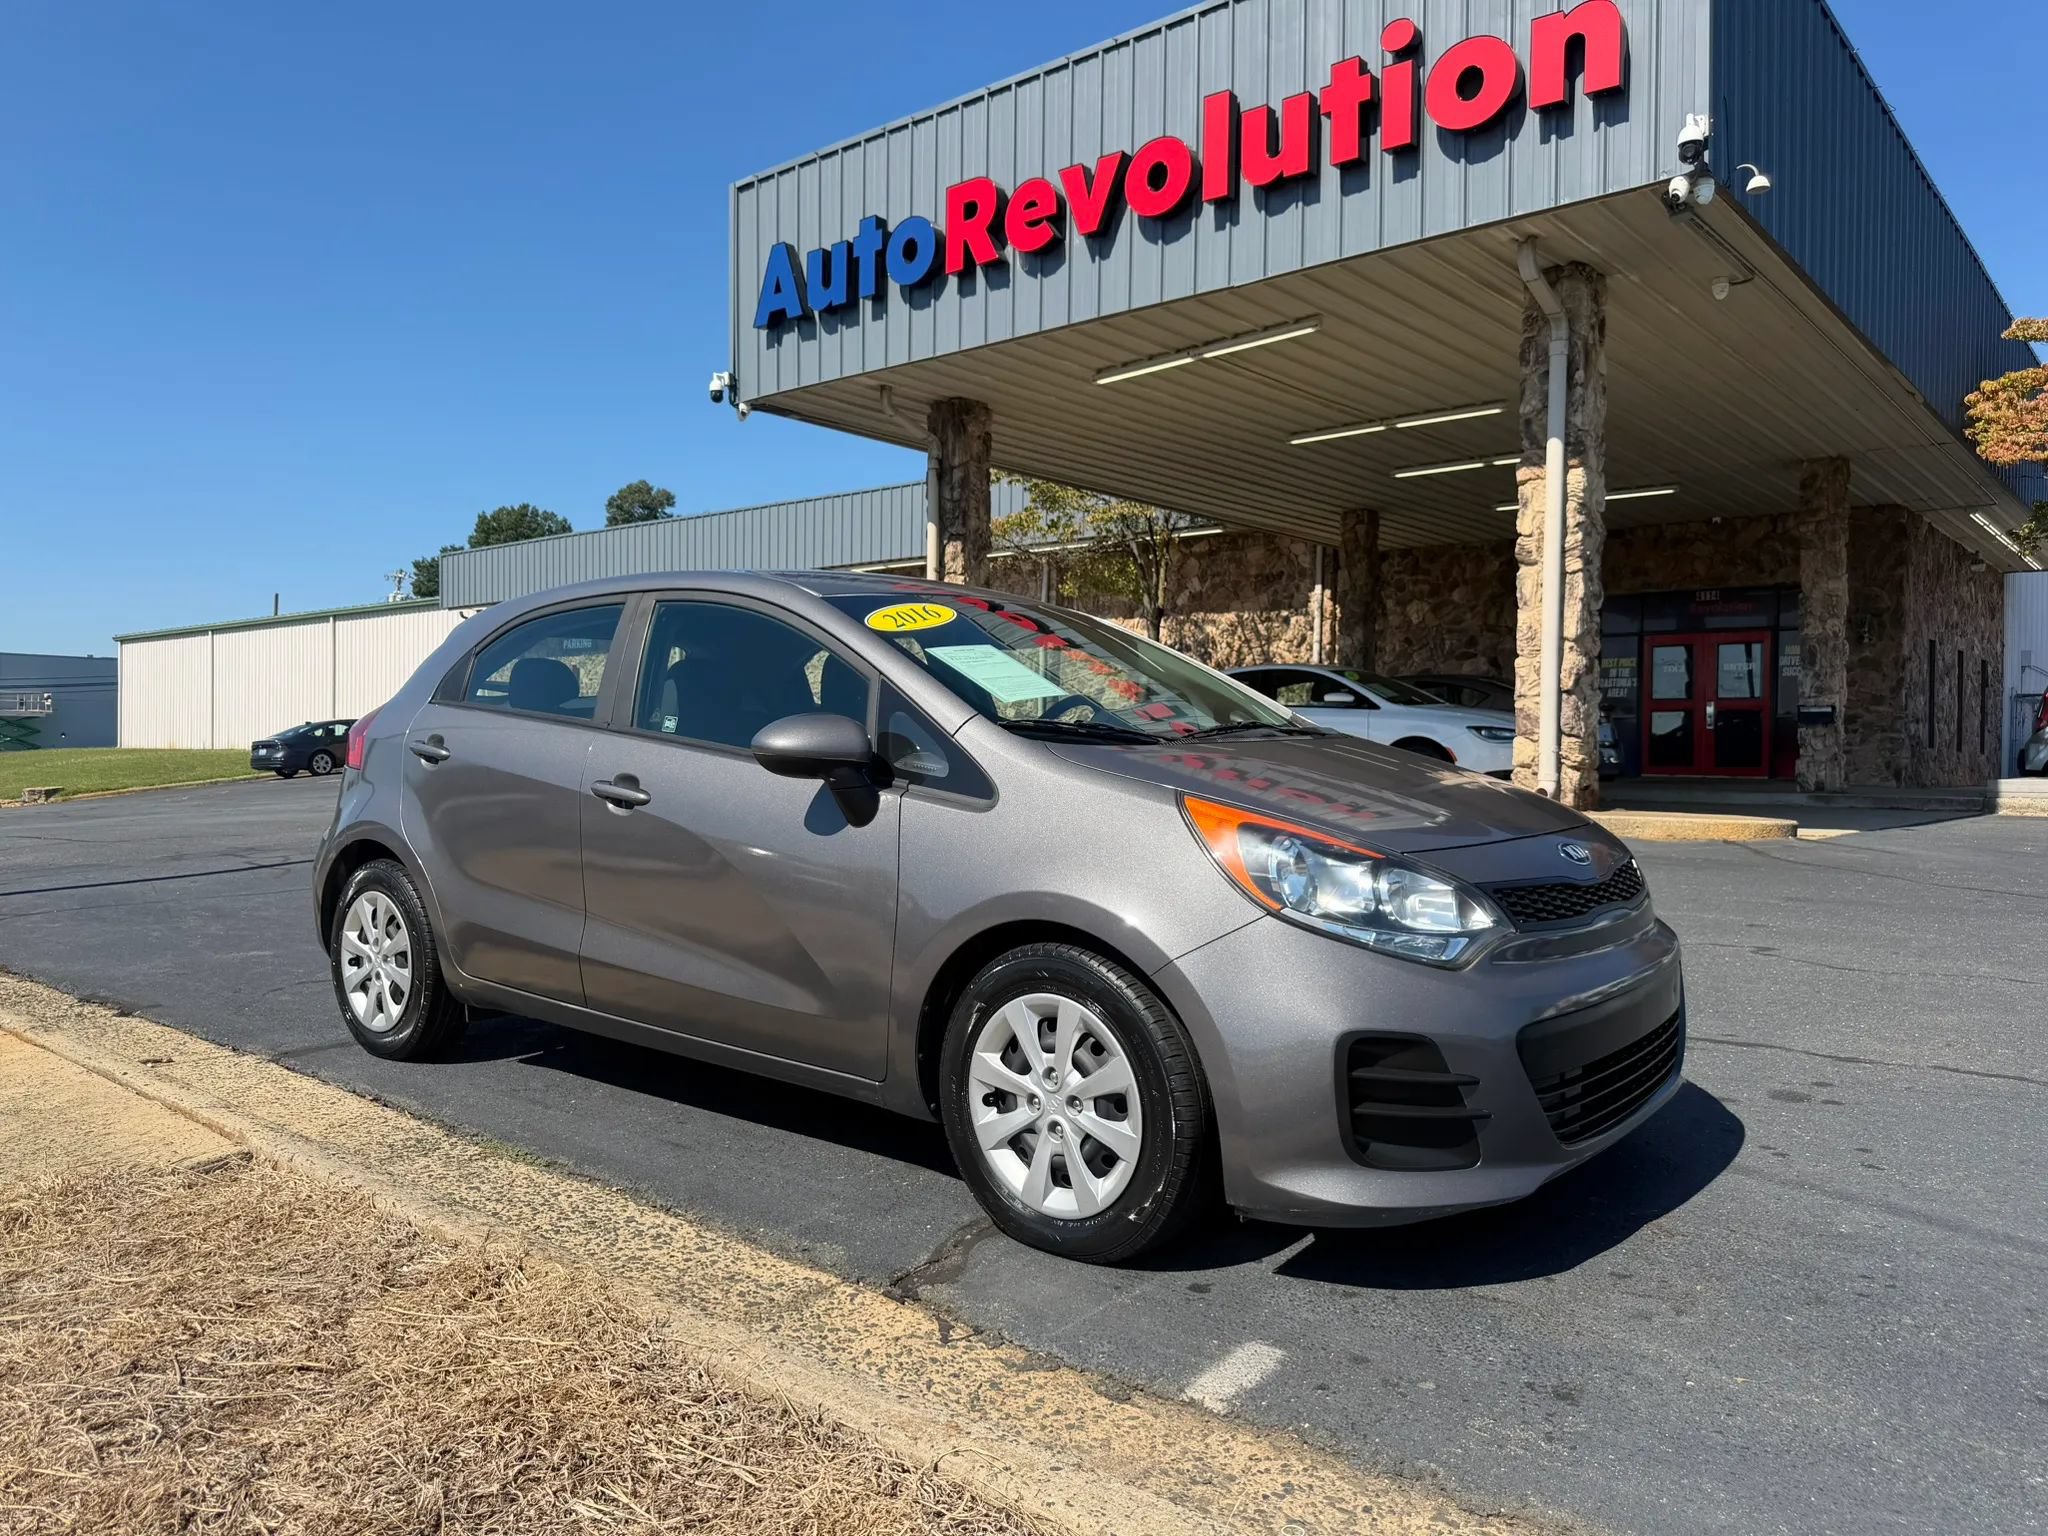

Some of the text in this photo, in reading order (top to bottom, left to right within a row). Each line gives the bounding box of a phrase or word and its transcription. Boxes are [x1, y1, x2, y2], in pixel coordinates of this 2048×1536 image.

[753, 0, 1627, 328] AutoRevolution
[882, 605, 942, 628] 2016
[563, 638, 592, 649] PARKING
[1609, 668, 1630, 678] IN THE
